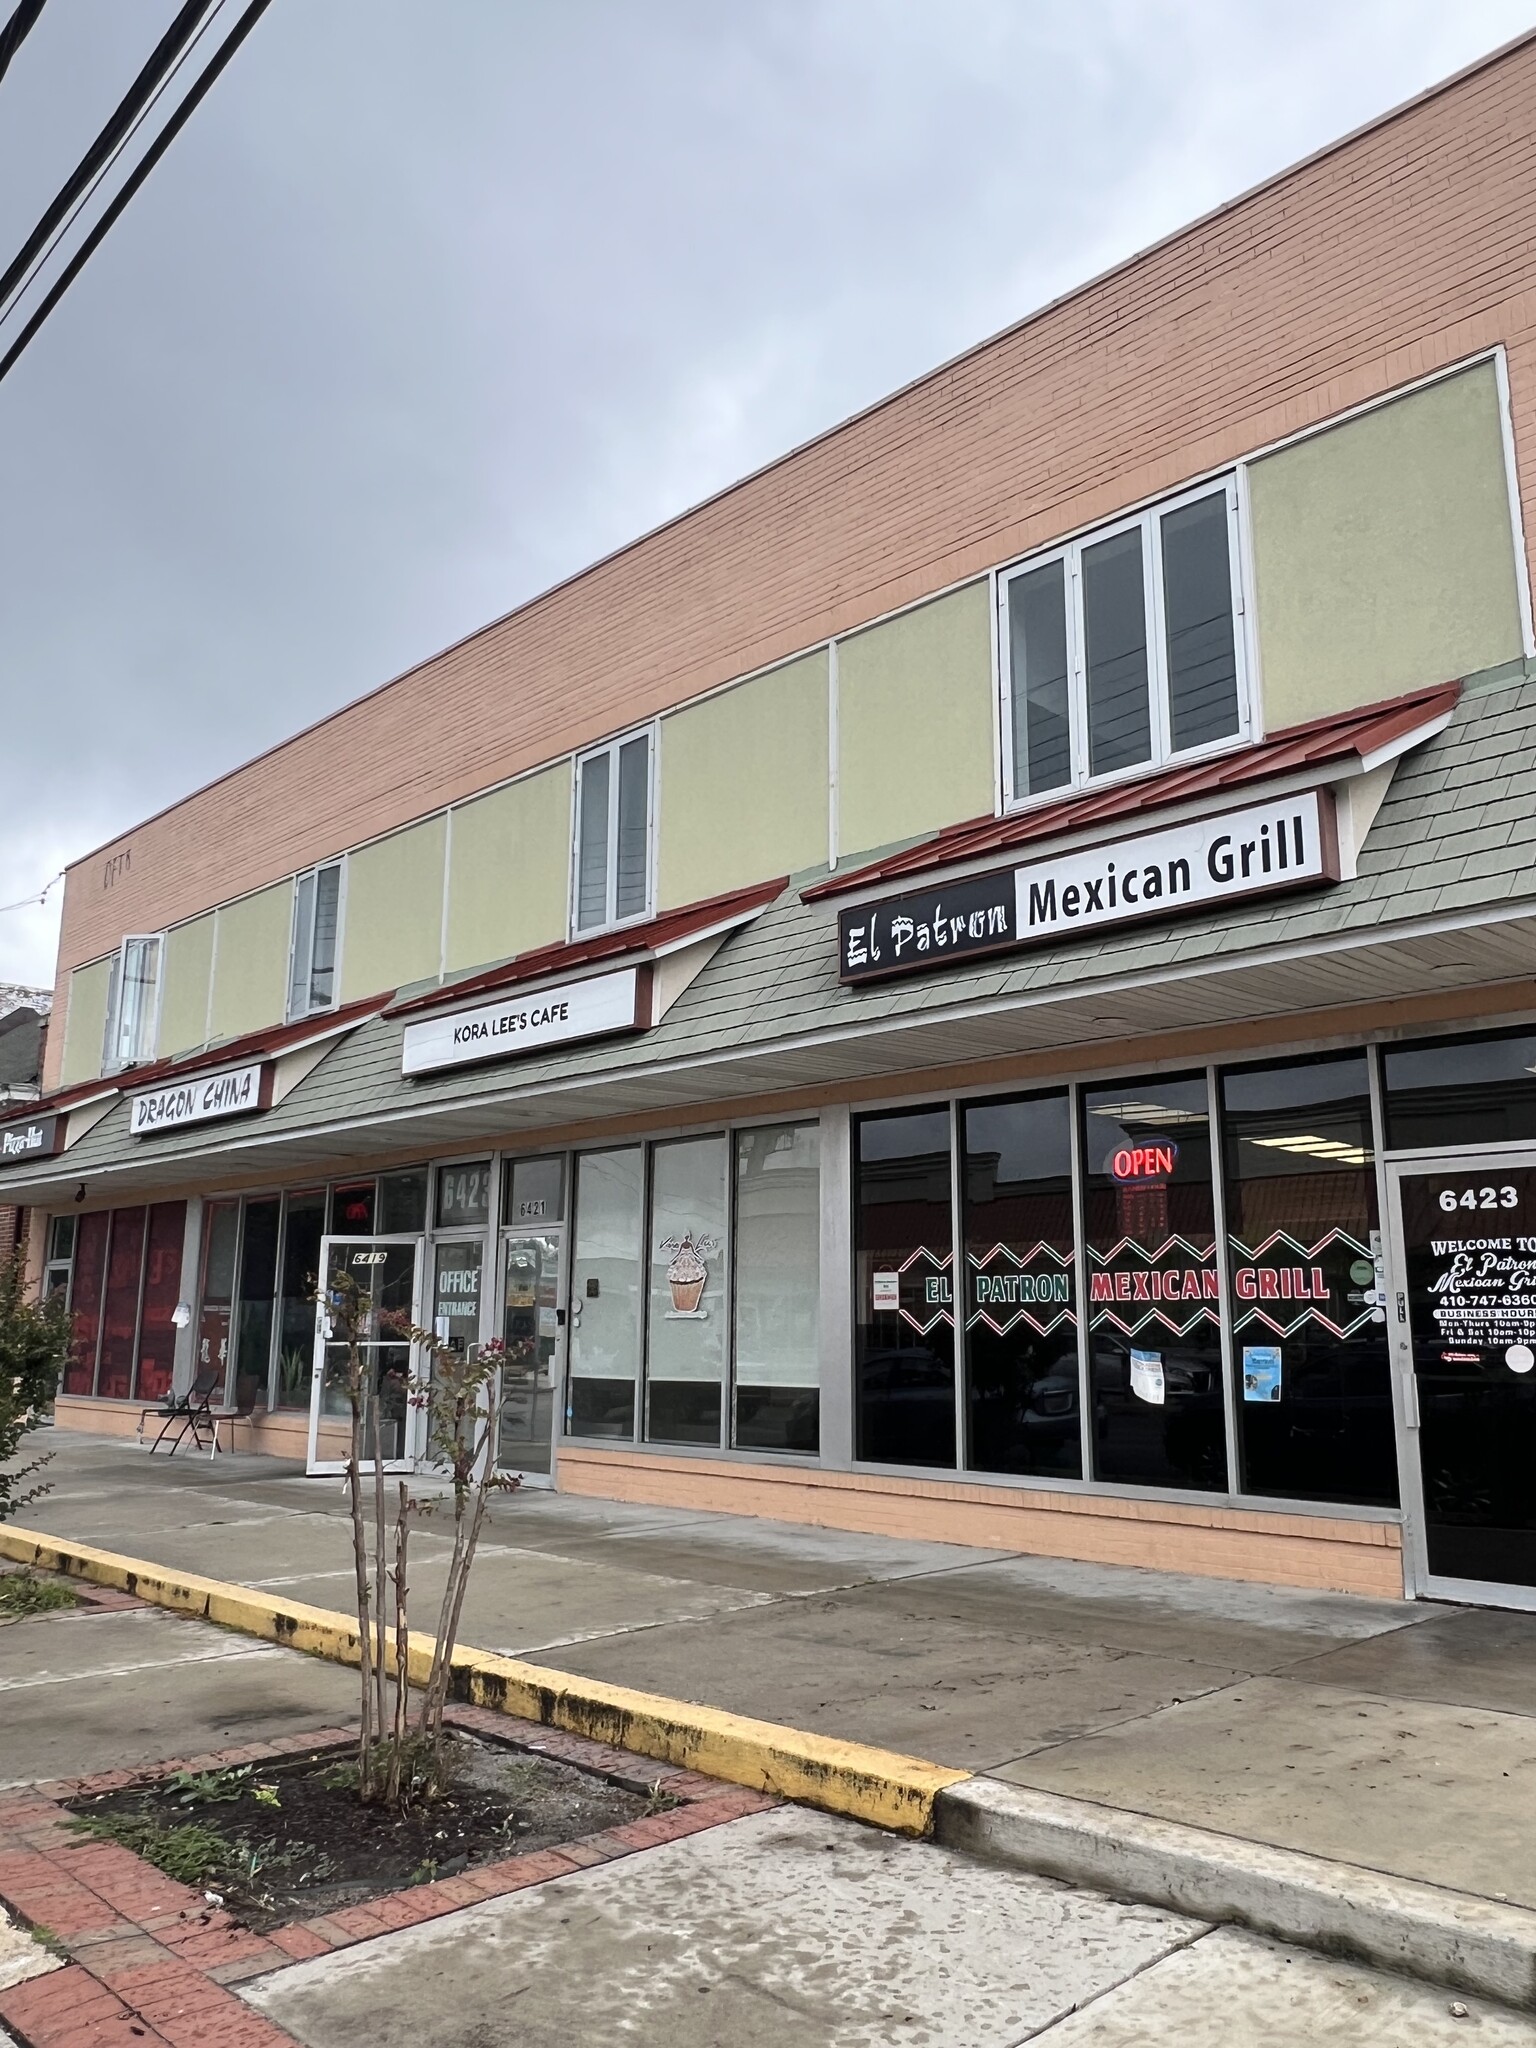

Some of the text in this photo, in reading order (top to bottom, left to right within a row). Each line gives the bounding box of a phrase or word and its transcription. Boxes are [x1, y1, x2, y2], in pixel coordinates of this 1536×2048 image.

[1028, 815, 1305, 926] Mexican Grill
[847, 903, 1008, 968] El Patron
[453, 1002, 569, 1045] KORA LEE'S CAFE
[138, 1073, 252, 1126] DRAGON CHINA
[1114, 1146, 1173, 1177] OPEN
[520, 1200, 547, 1217] 6421
[1439, 1185, 1519, 1212] 6423
[354, 1253, 387, 1264] 6419
[1430, 1236, 1536, 1257] WELCOME TO
[1450, 1252, 1536, 1277] El Patron
[439, 1270, 479, 1293] OFFICE
[925, 1276, 952, 1303] EL
[976, 1274, 1069, 1303] PATRON
[1090, 1269, 1219, 1301] MEXICAN
[1235, 1266, 1330, 1300] GRILL
[1427, 1271, 1506, 1293] Mexican
[438, 1301, 477, 1316] ENTRANCE
[1440, 1309, 1536, 1318] BUSINESS HOUR
[1448, 1337, 1483, 1345] Sunday
